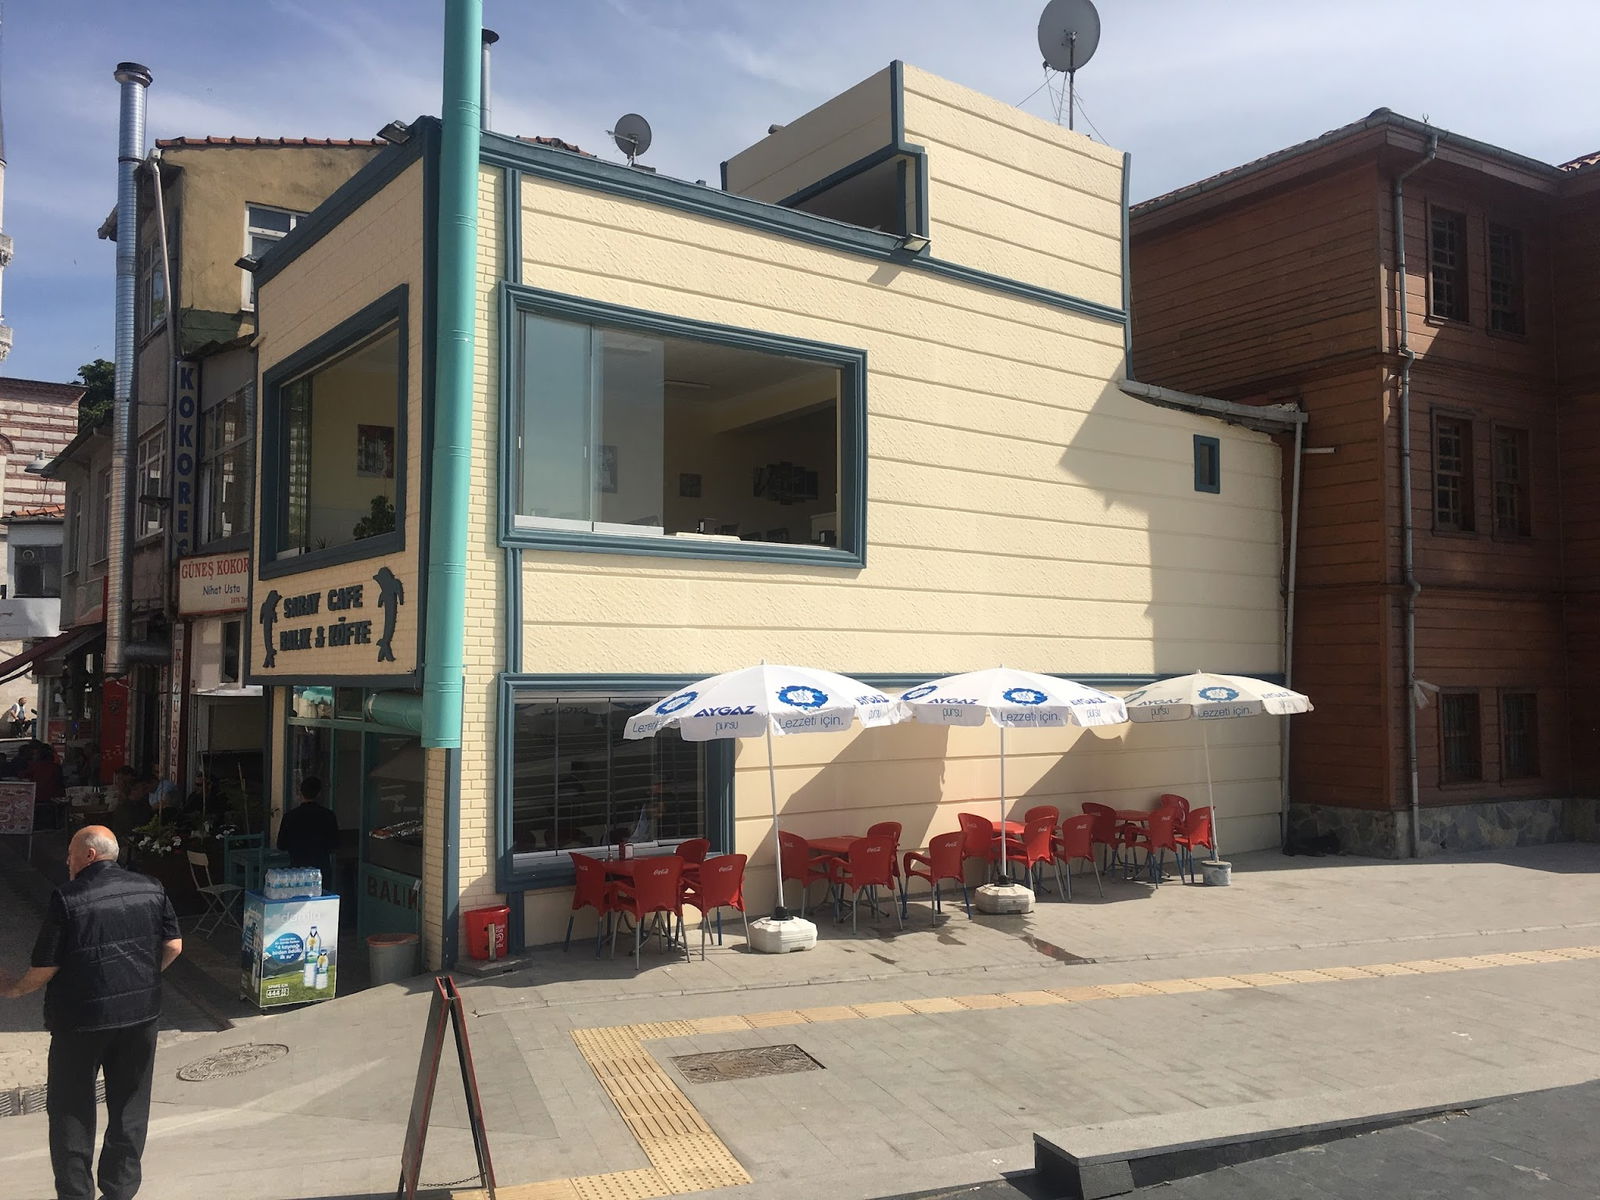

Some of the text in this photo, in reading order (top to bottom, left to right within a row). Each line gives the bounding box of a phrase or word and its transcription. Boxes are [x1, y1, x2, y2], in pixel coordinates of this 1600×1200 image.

[182, 561, 214, 580] GÜNEŞ
[203, 584, 241, 596] Nihat Usta
[327, 584, 364, 611] CAFE
[279, 616, 372, 651] BALIK & KÖFTE
[693, 705, 757, 718] AYGAZ
[1000, 711, 1061, 723] Lezzeti için.
[779, 715, 844, 729] Lezzeti için.
